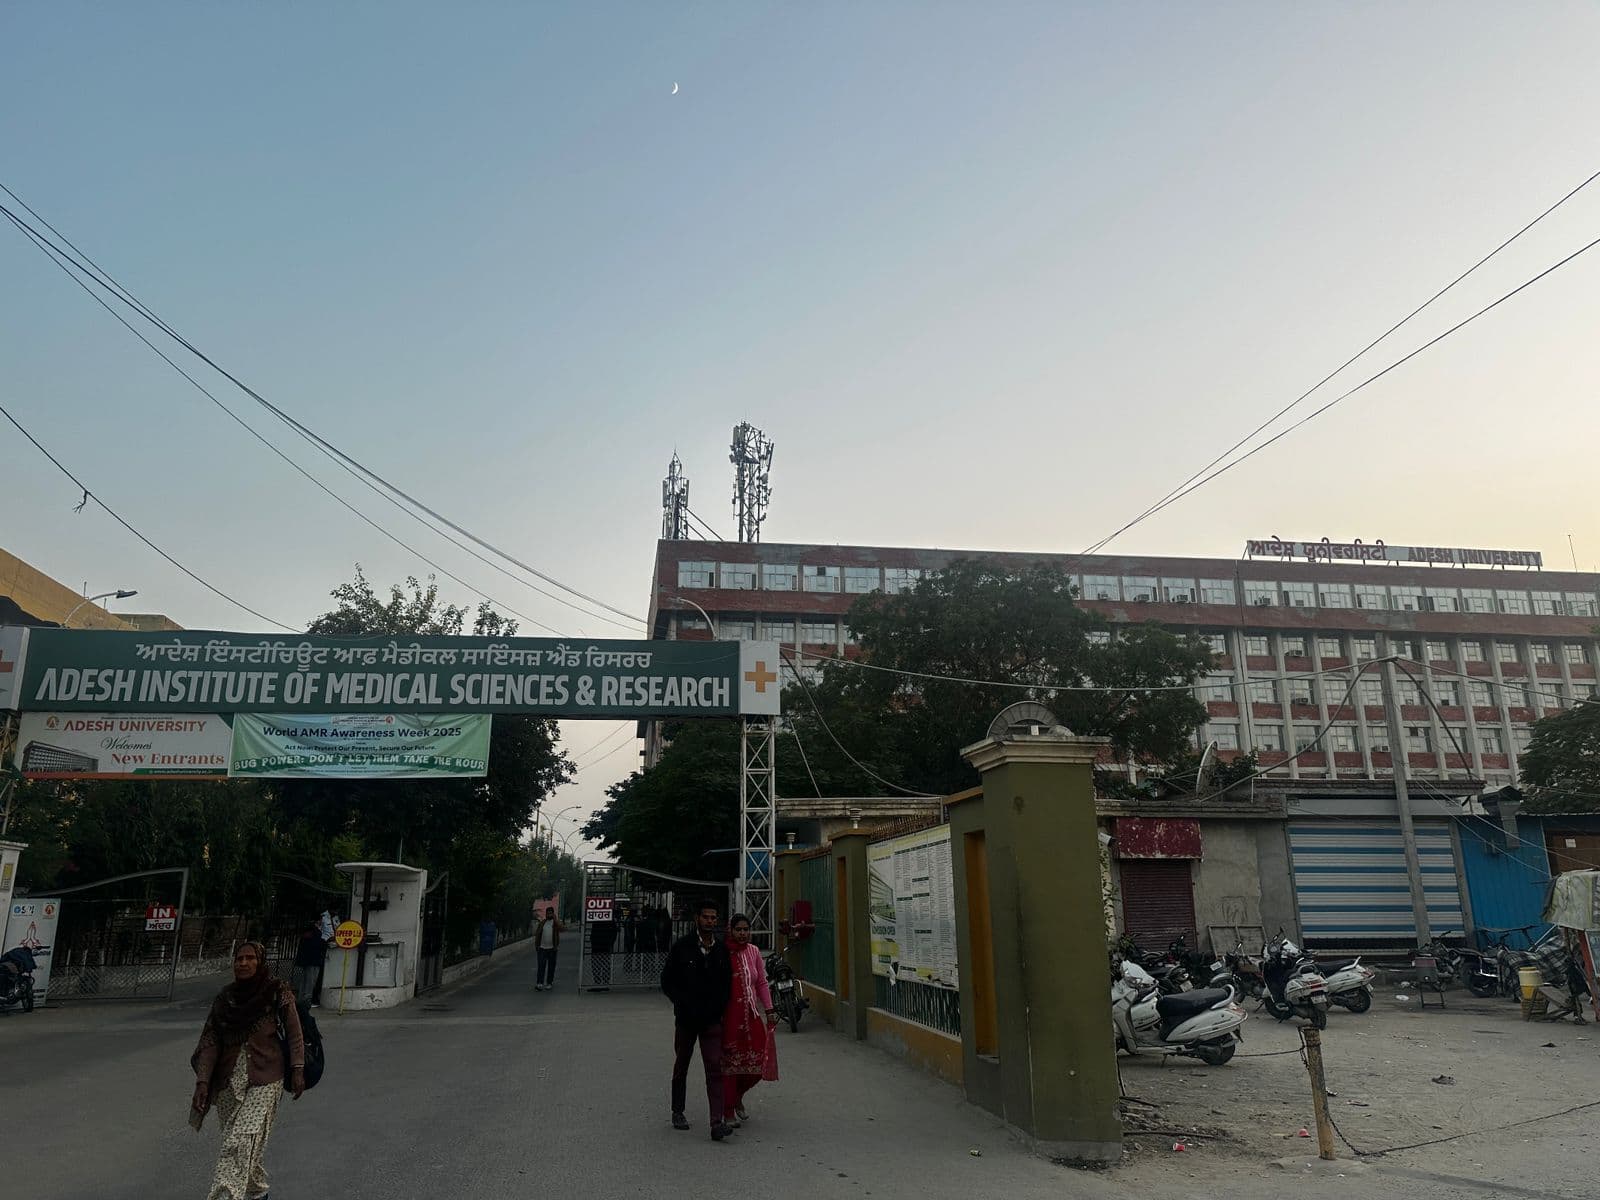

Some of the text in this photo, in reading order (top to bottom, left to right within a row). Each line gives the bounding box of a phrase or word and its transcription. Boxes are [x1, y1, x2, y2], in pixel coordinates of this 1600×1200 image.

[1408, 547, 1540, 566] ADESH UNIVERSITY
[135, 638, 201, 662] ਆਦੇਸ਼
[332, 647, 379, 666] ਆਫ਼
[382, 640, 459, 665] ਮੈਡੀਕਲ
[547, 643, 583, 668] ਐਂਡ
[585, 646, 653, 668] ਰਿਸਰਚ
[35, 667, 730, 707] ADESH INSTITUTE OF MEDICAL SCIENCES & RESEARCH
[63, 720, 207, 732] ADESH UNIVERSITY
[263, 727, 462, 738] World AMR Awareness Week 2025
[100, 735, 154, 751] Welcomes
[111, 753, 225, 765] New Entrants
[234, 759, 257, 770] BUG
[262, 754, 304, 767] POWER:
[309, 753, 343, 763] DON'T
[348, 754, 367, 762] LET
[371, 754, 399, 763] THEM
[404, 755, 430, 764] TAKE
[434, 756, 451, 766] THE
[588, 899, 612, 909] OUT
[152, 908, 171, 918] IN
[342, 937, 352, 946] 20
